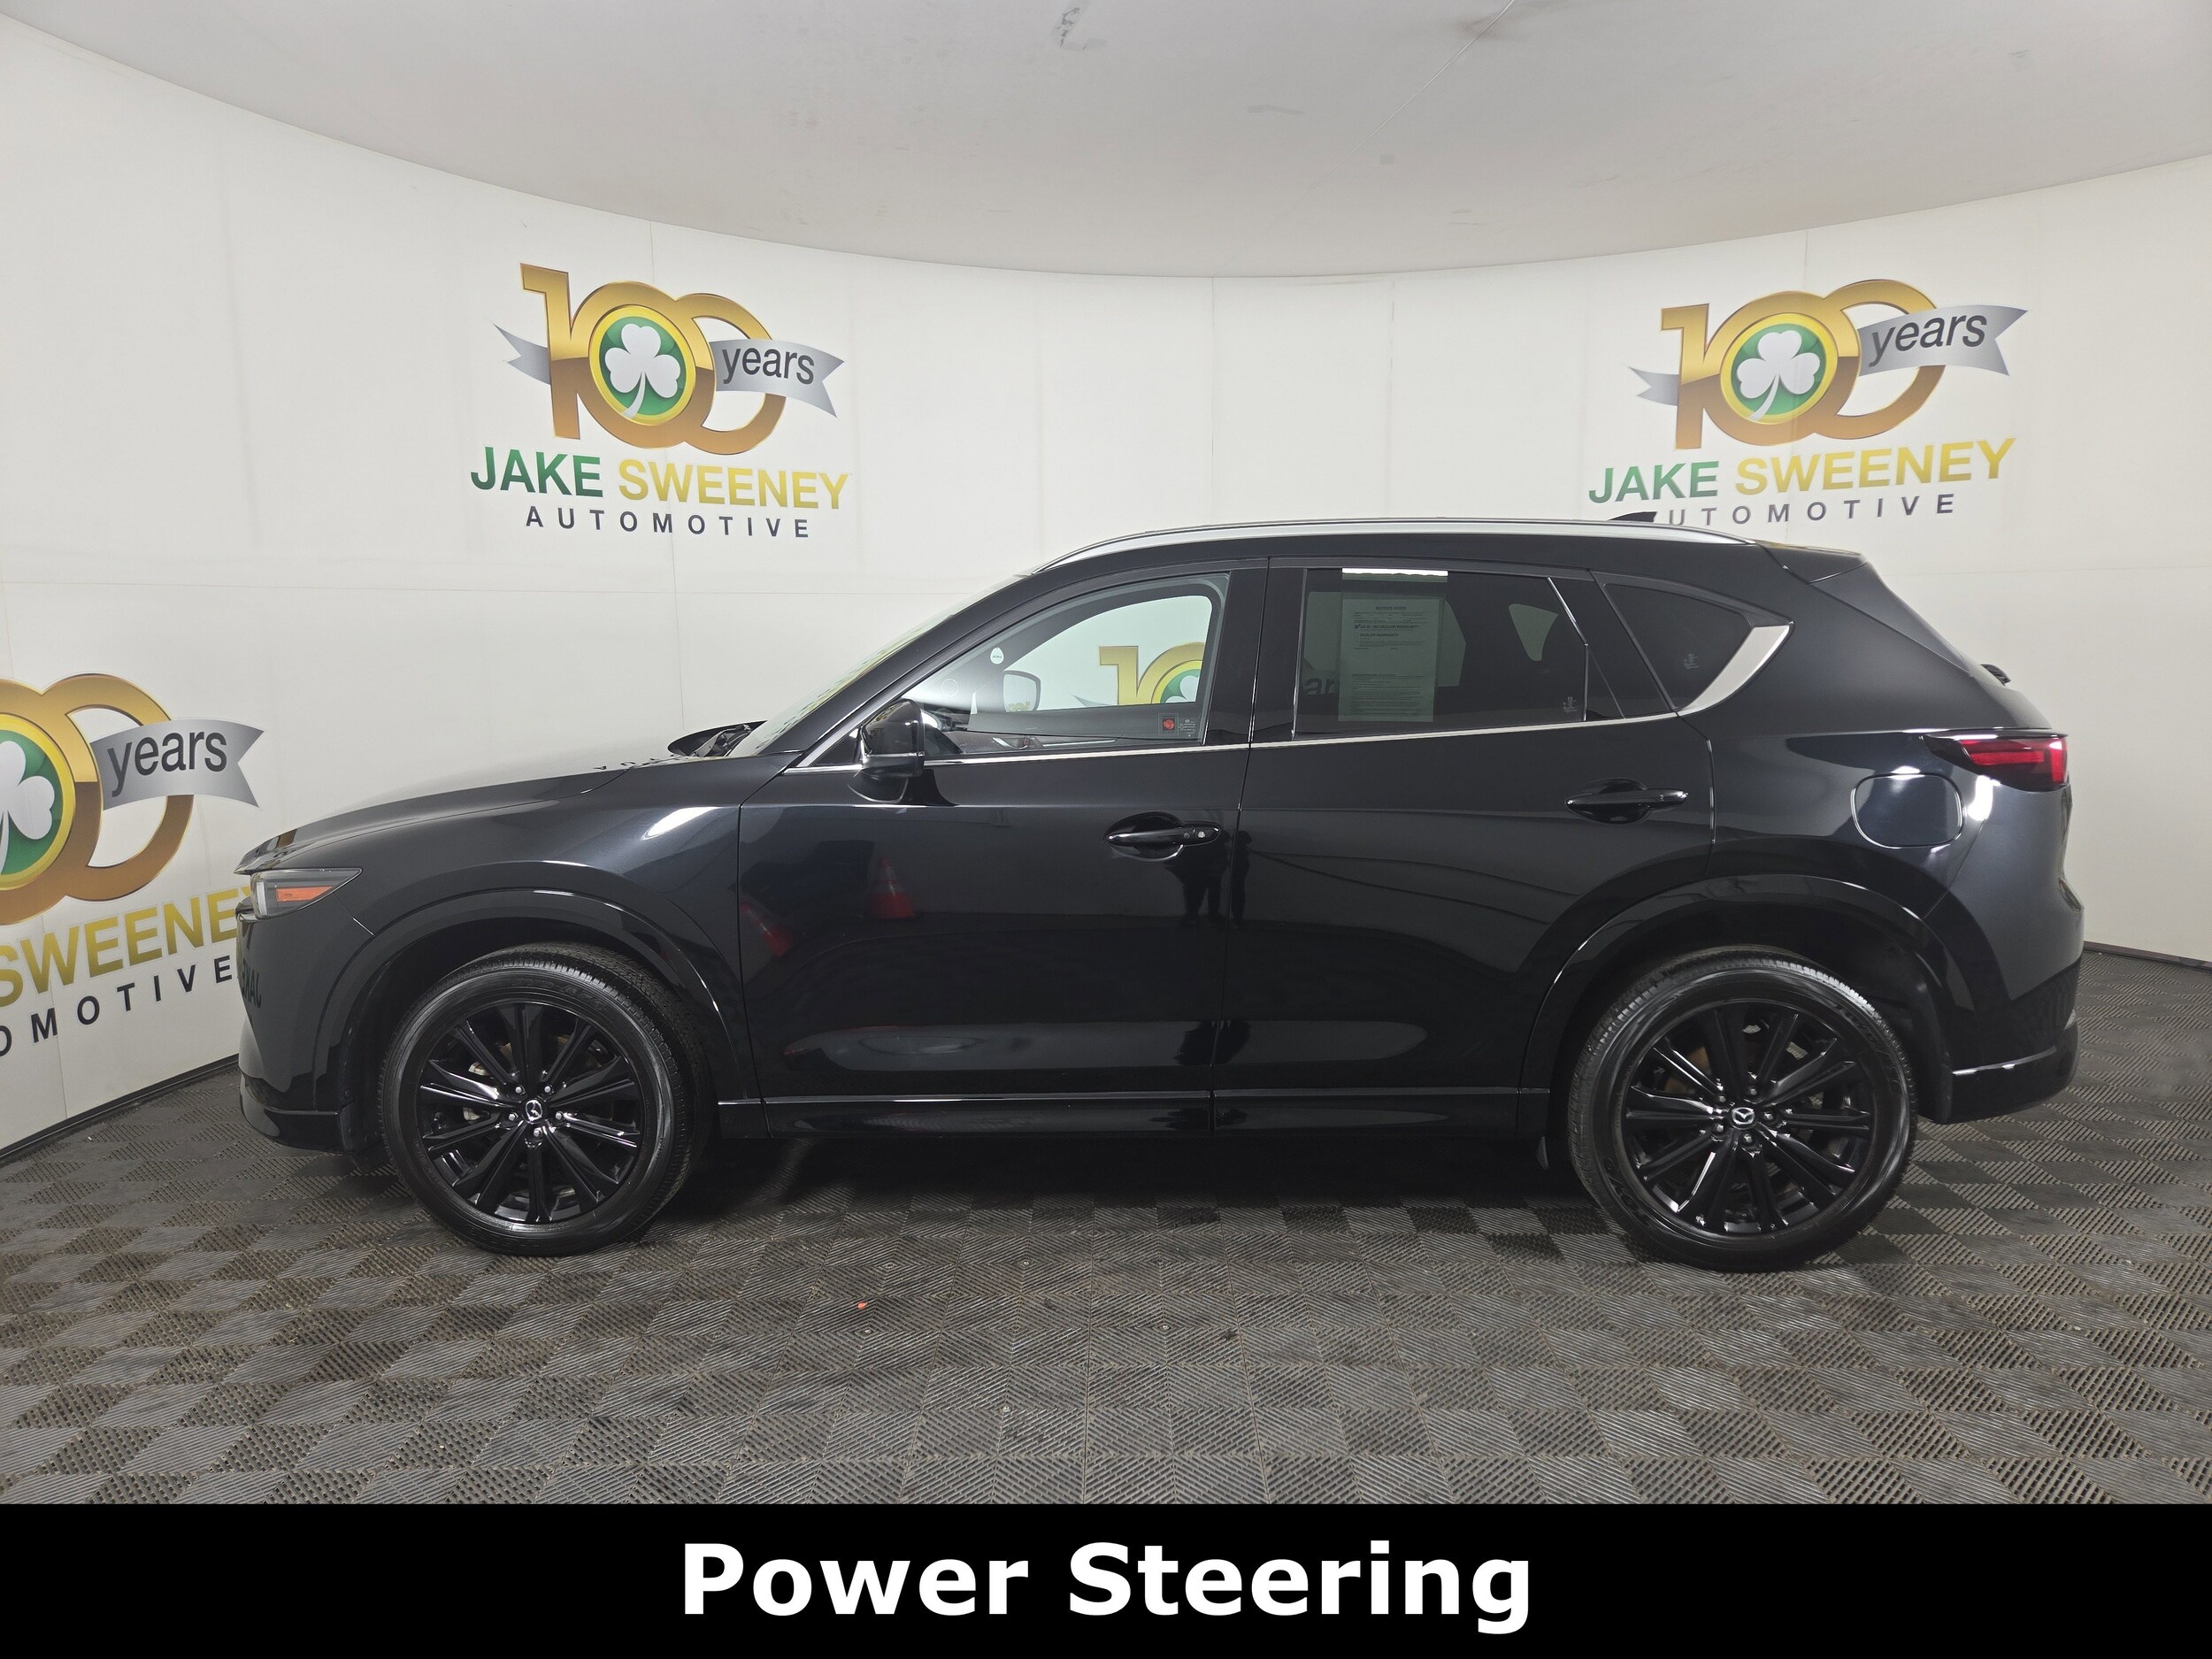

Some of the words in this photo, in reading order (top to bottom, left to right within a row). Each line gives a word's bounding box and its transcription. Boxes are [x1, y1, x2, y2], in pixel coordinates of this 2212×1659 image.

[721, 346, 816, 386] years
[1868, 312, 1988, 368] years
[470, 445, 604, 497] JAKE
[618, 458, 849, 510] SWEENEY
[1588, 460, 1719, 504] JAKE
[1735, 437, 2016, 495] SWEENEY
[526, 505, 809, 538] AUTOMOTIVE
[1669, 493, 1955, 526] UTOMOTIVE
[107, 730, 228, 797] years
[0, 885, 250, 1008] SWEENE
